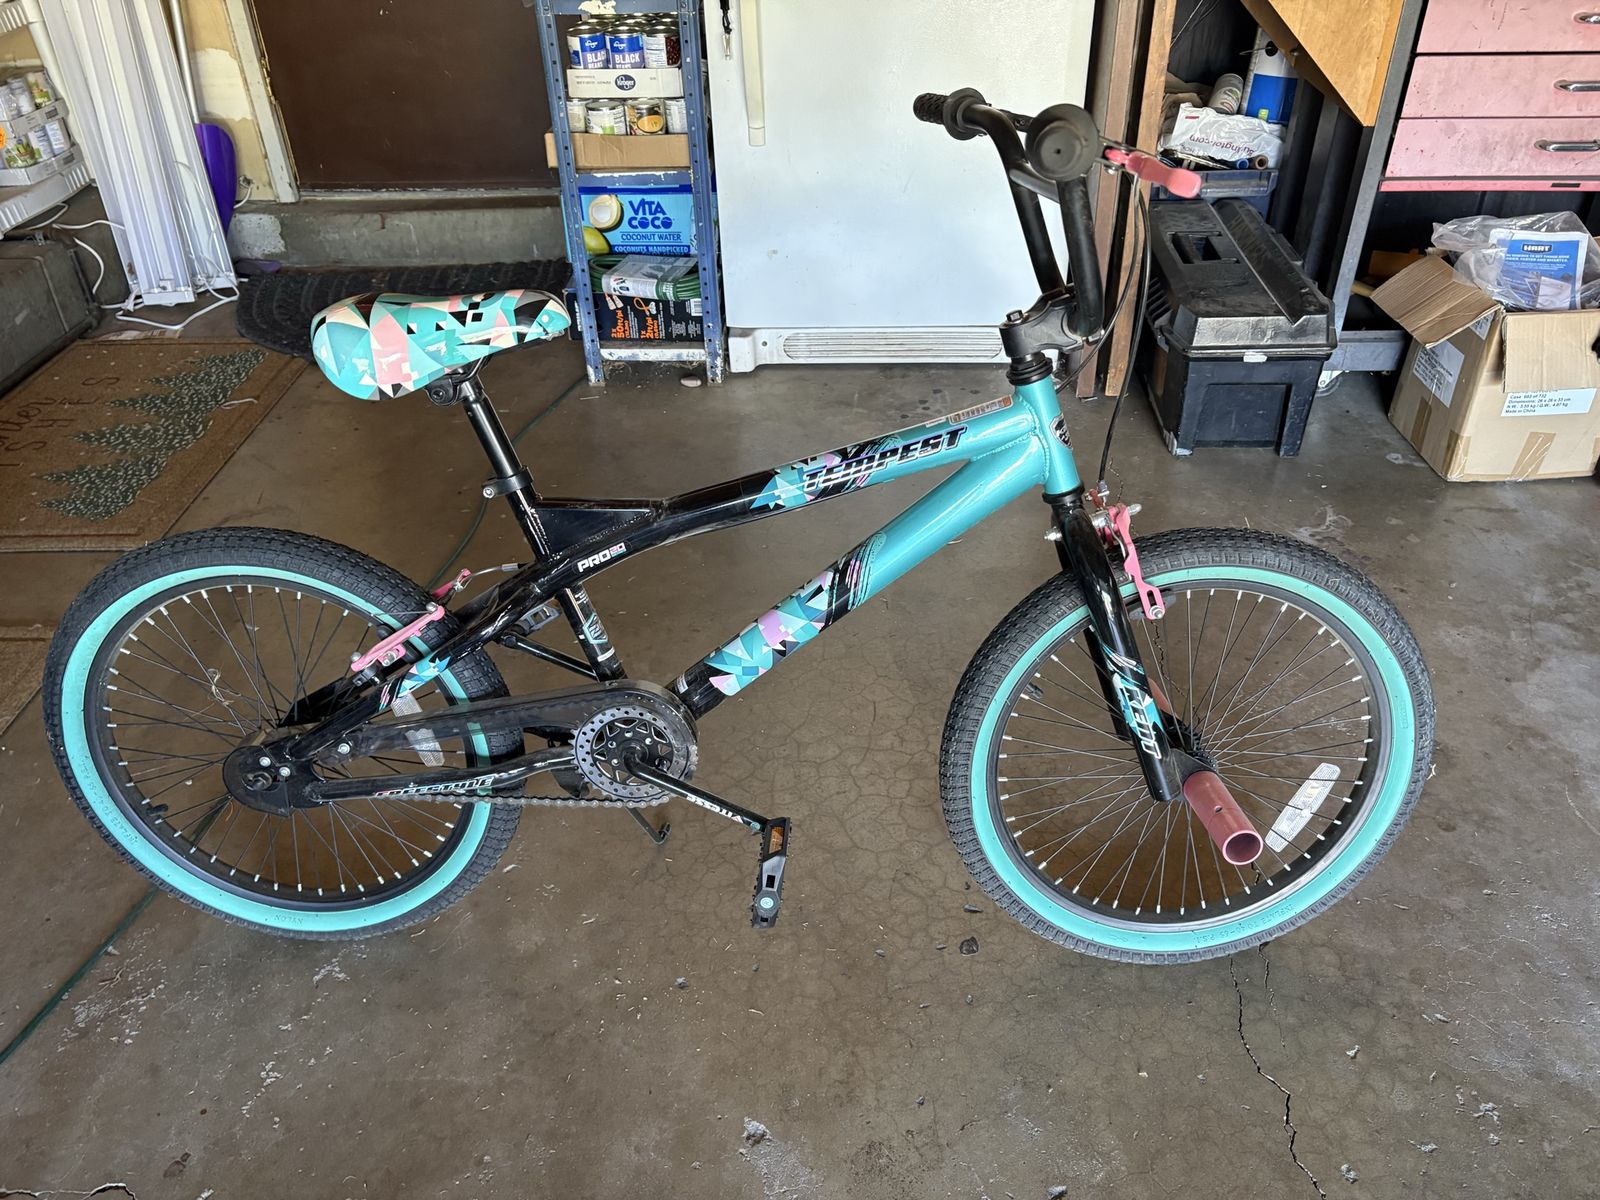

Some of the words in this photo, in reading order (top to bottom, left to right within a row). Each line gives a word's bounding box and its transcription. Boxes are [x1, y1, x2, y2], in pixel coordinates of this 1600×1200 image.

[614, 53, 640, 63] BLACK
[616, 75, 634, 90] Kroger
[628, 198, 668, 216] VITA
[627, 216, 673, 230] COCO
[621, 233, 657, 241] COCONUT
[657, 233, 682, 241] WATER
[803, 425, 968, 491] TEMPEST
[1120, 684, 1162, 759] KENT
